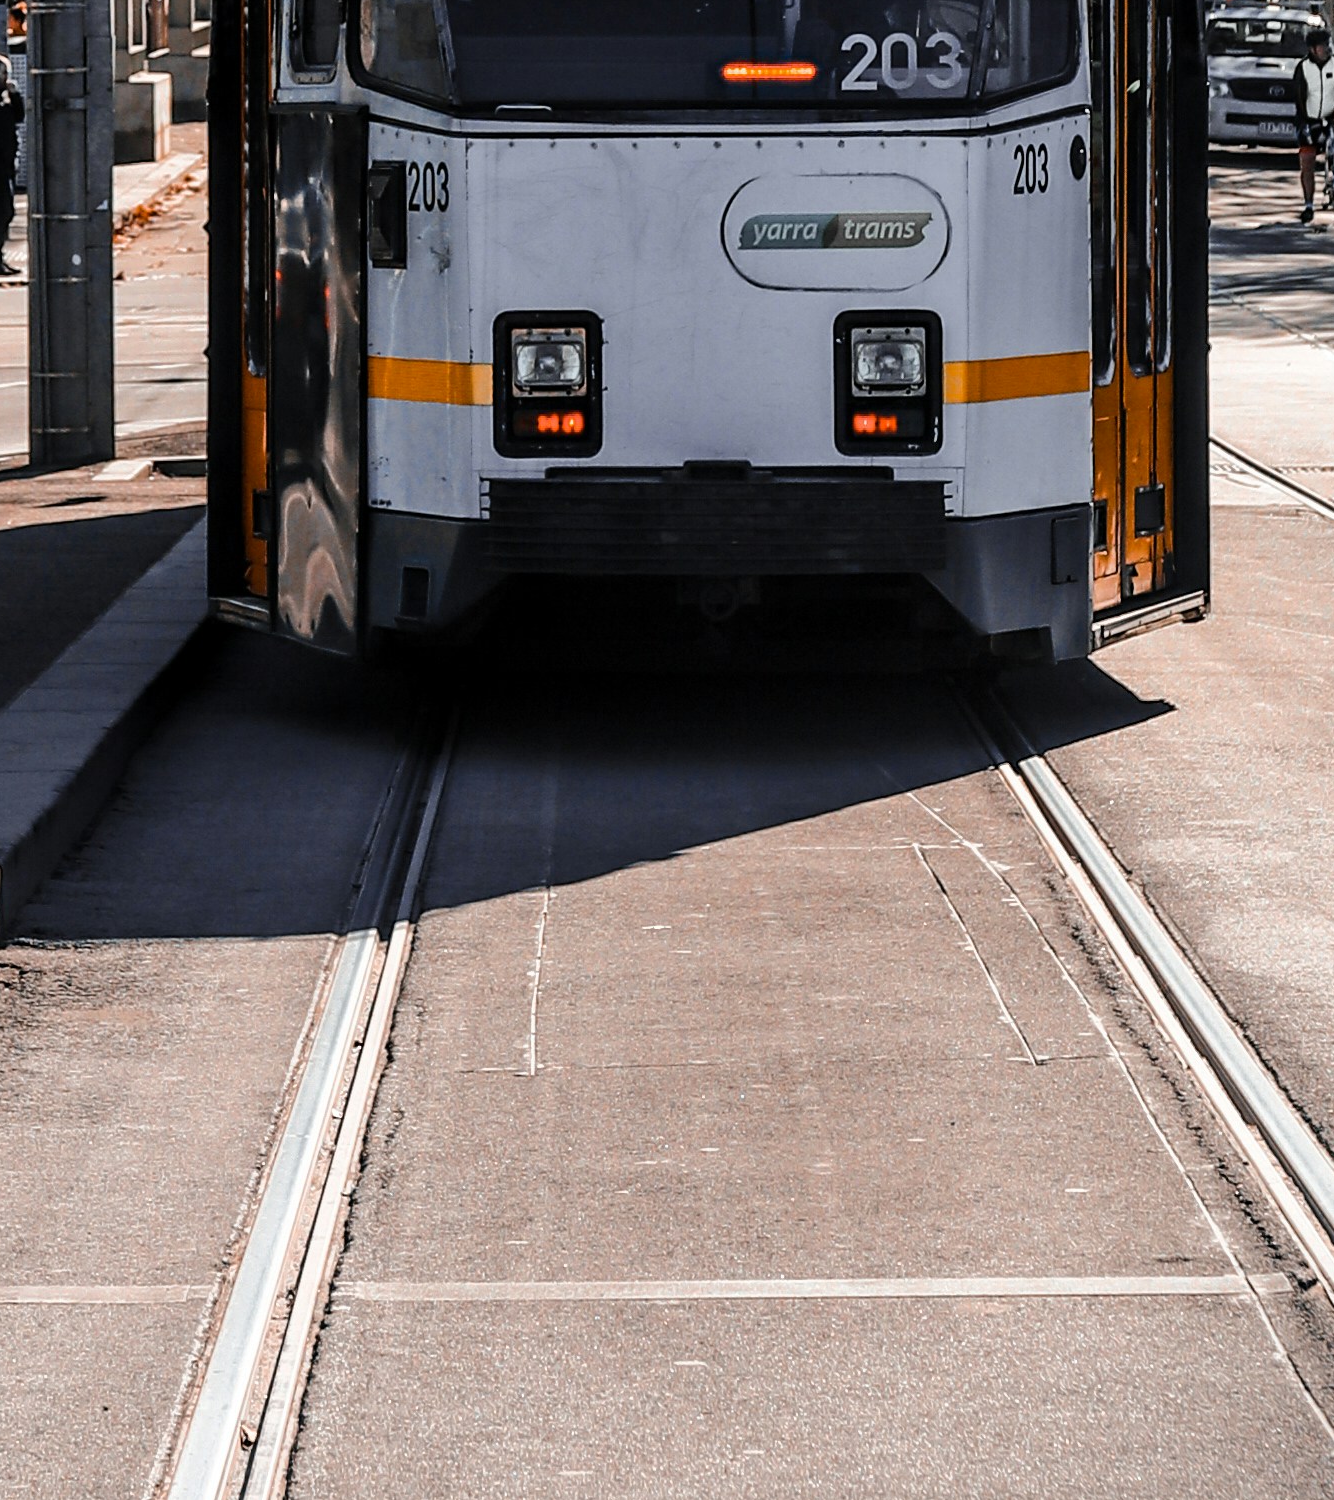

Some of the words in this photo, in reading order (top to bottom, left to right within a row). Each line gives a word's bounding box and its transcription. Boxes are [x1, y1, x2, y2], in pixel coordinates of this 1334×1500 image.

[840, 32, 963, 92] 203
[407, 161, 450, 213] 203
[1013, 142, 1050, 195] 203
[752, 220, 818, 246] yarra
[843, 215, 916, 241] trams
